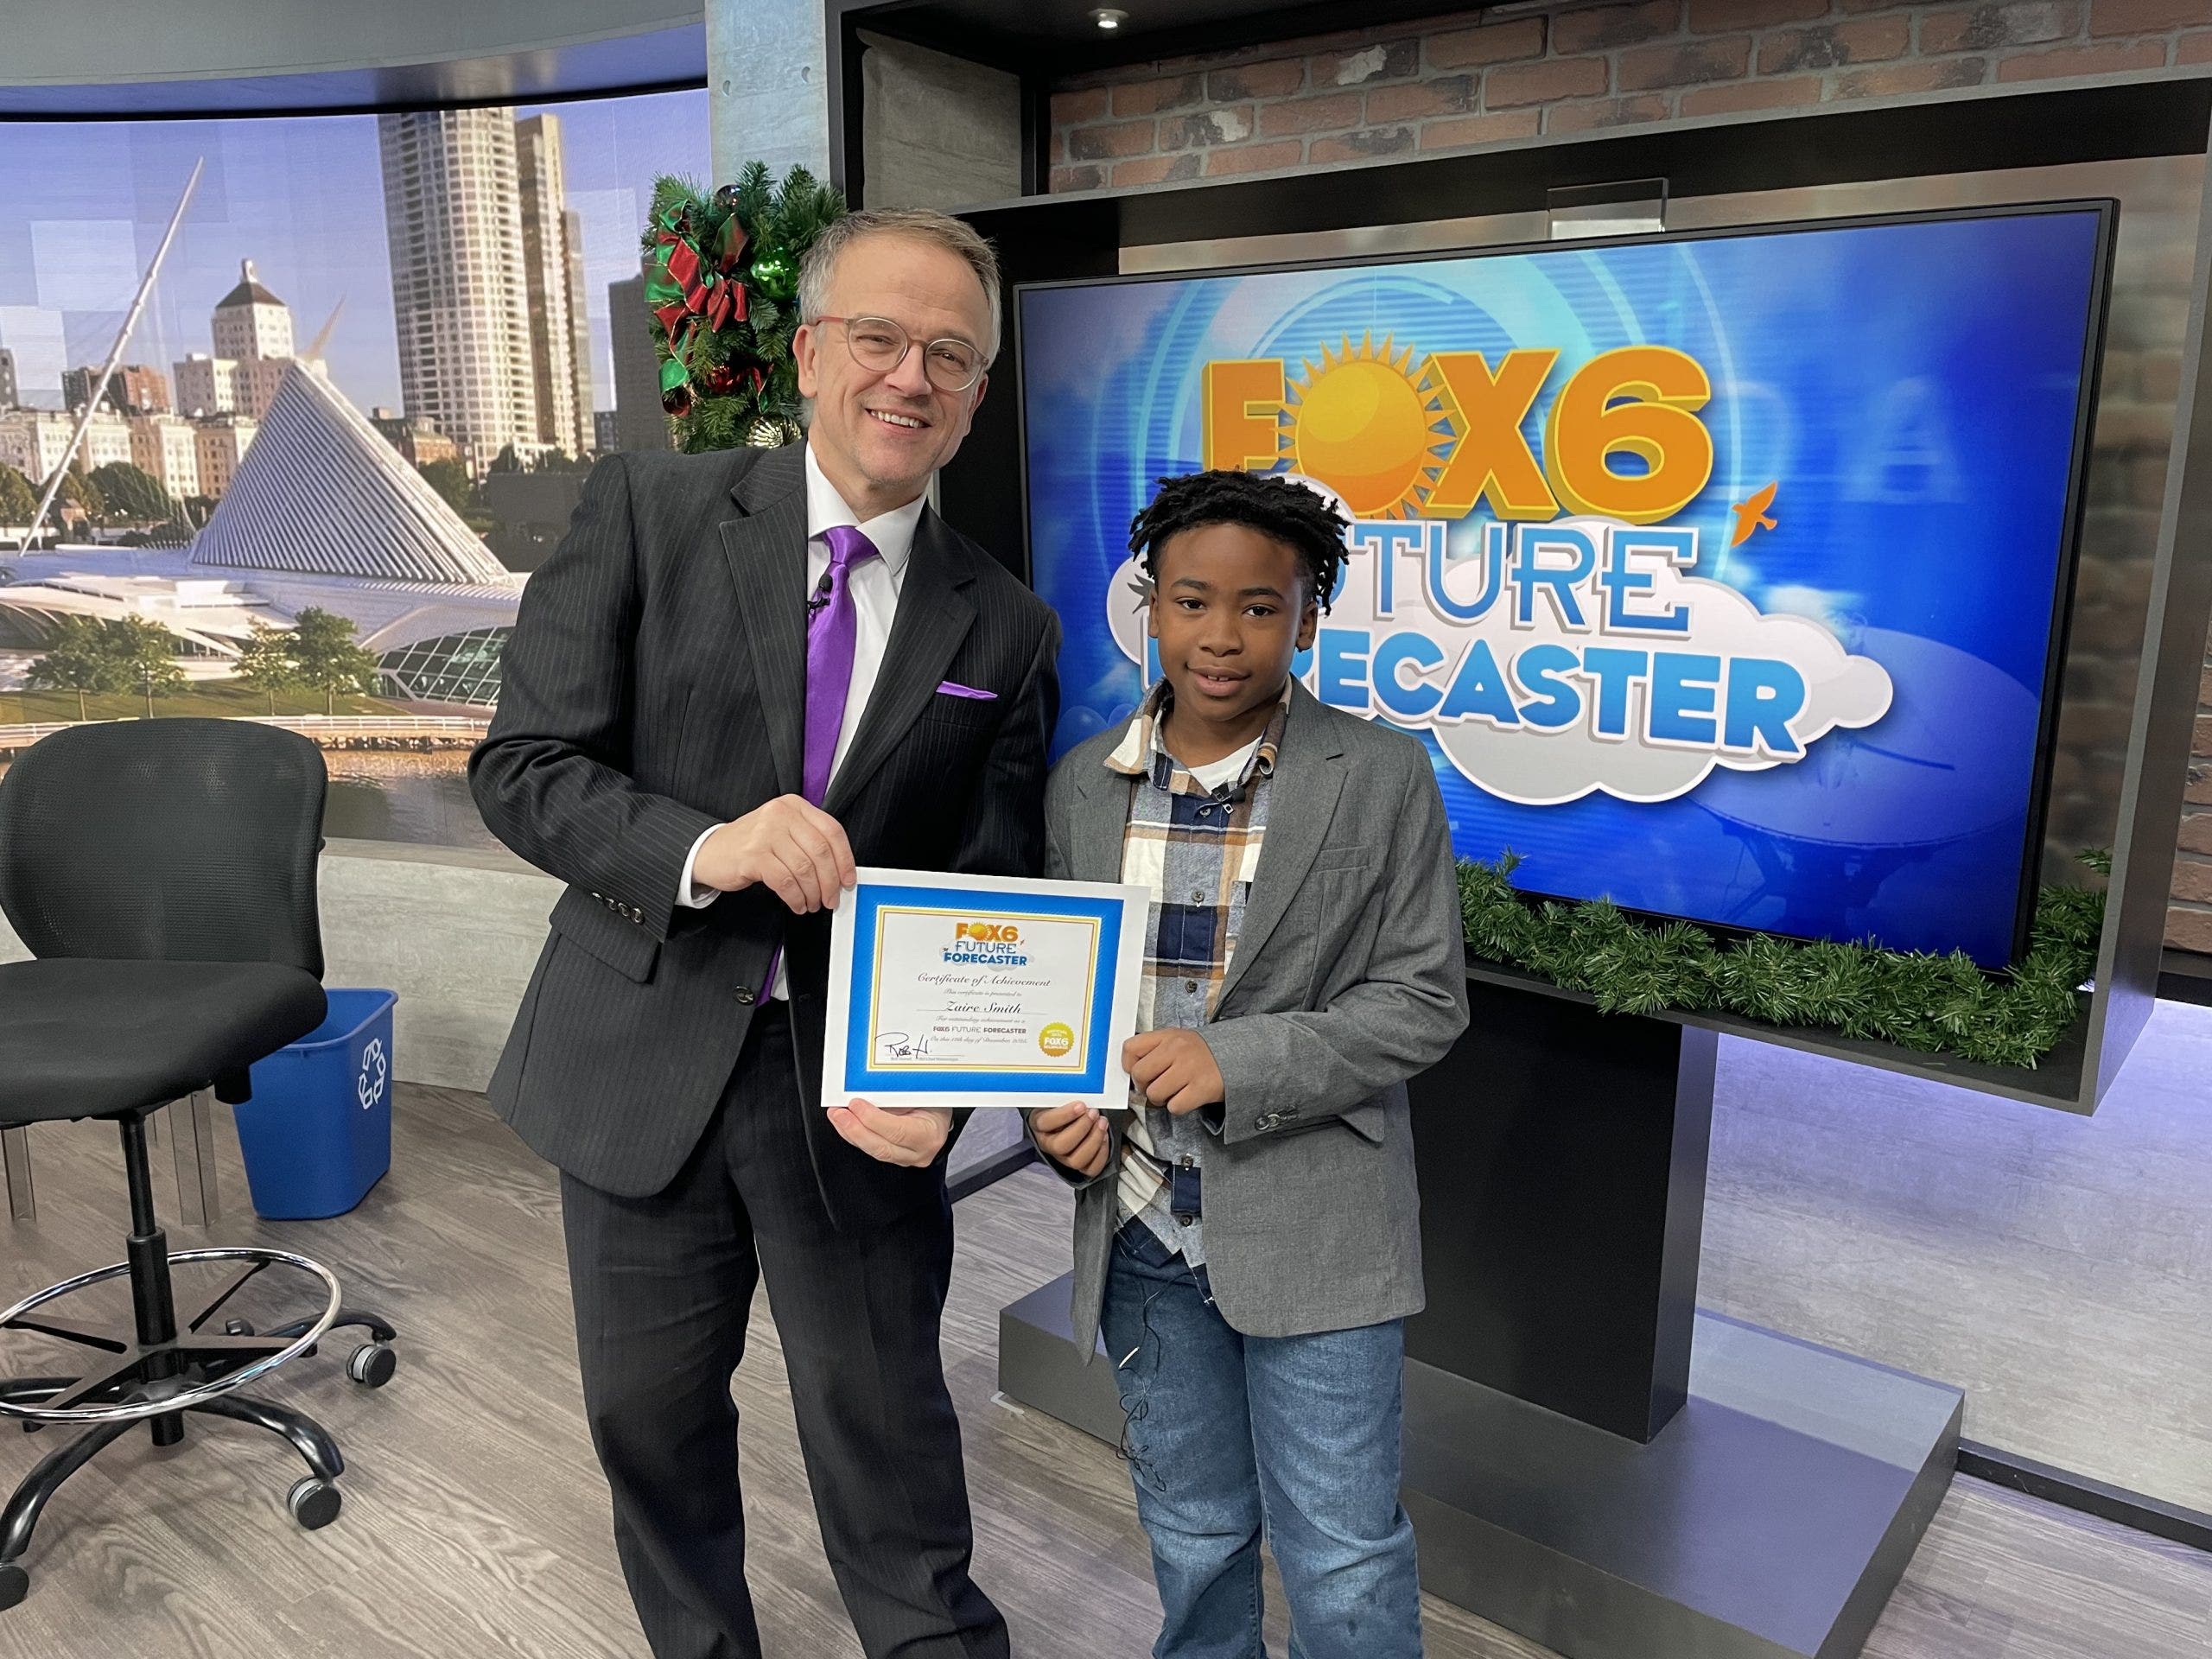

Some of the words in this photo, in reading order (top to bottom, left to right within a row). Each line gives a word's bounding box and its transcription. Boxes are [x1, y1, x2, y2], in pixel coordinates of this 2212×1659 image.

[1201, 332, 1714, 525] FOX6
[1333, 523, 1699, 634] TURE
[1146, 626, 1808, 753] ECASTER
[955, 922, 1018, 943] FOX6
[955, 941, 1017, 954] FUTURE
[944, 952, 1027, 966] FORECASTER
[918, 973, 969, 986] Certificate
[971, 975, 984, 988] of
[984, 976, 1052, 987] Achievement
[945, 1001, 980, 1012] Zaire
[984, 1002, 1022, 1014] Smith
[1044, 1037, 1069, 1046] FOX6
